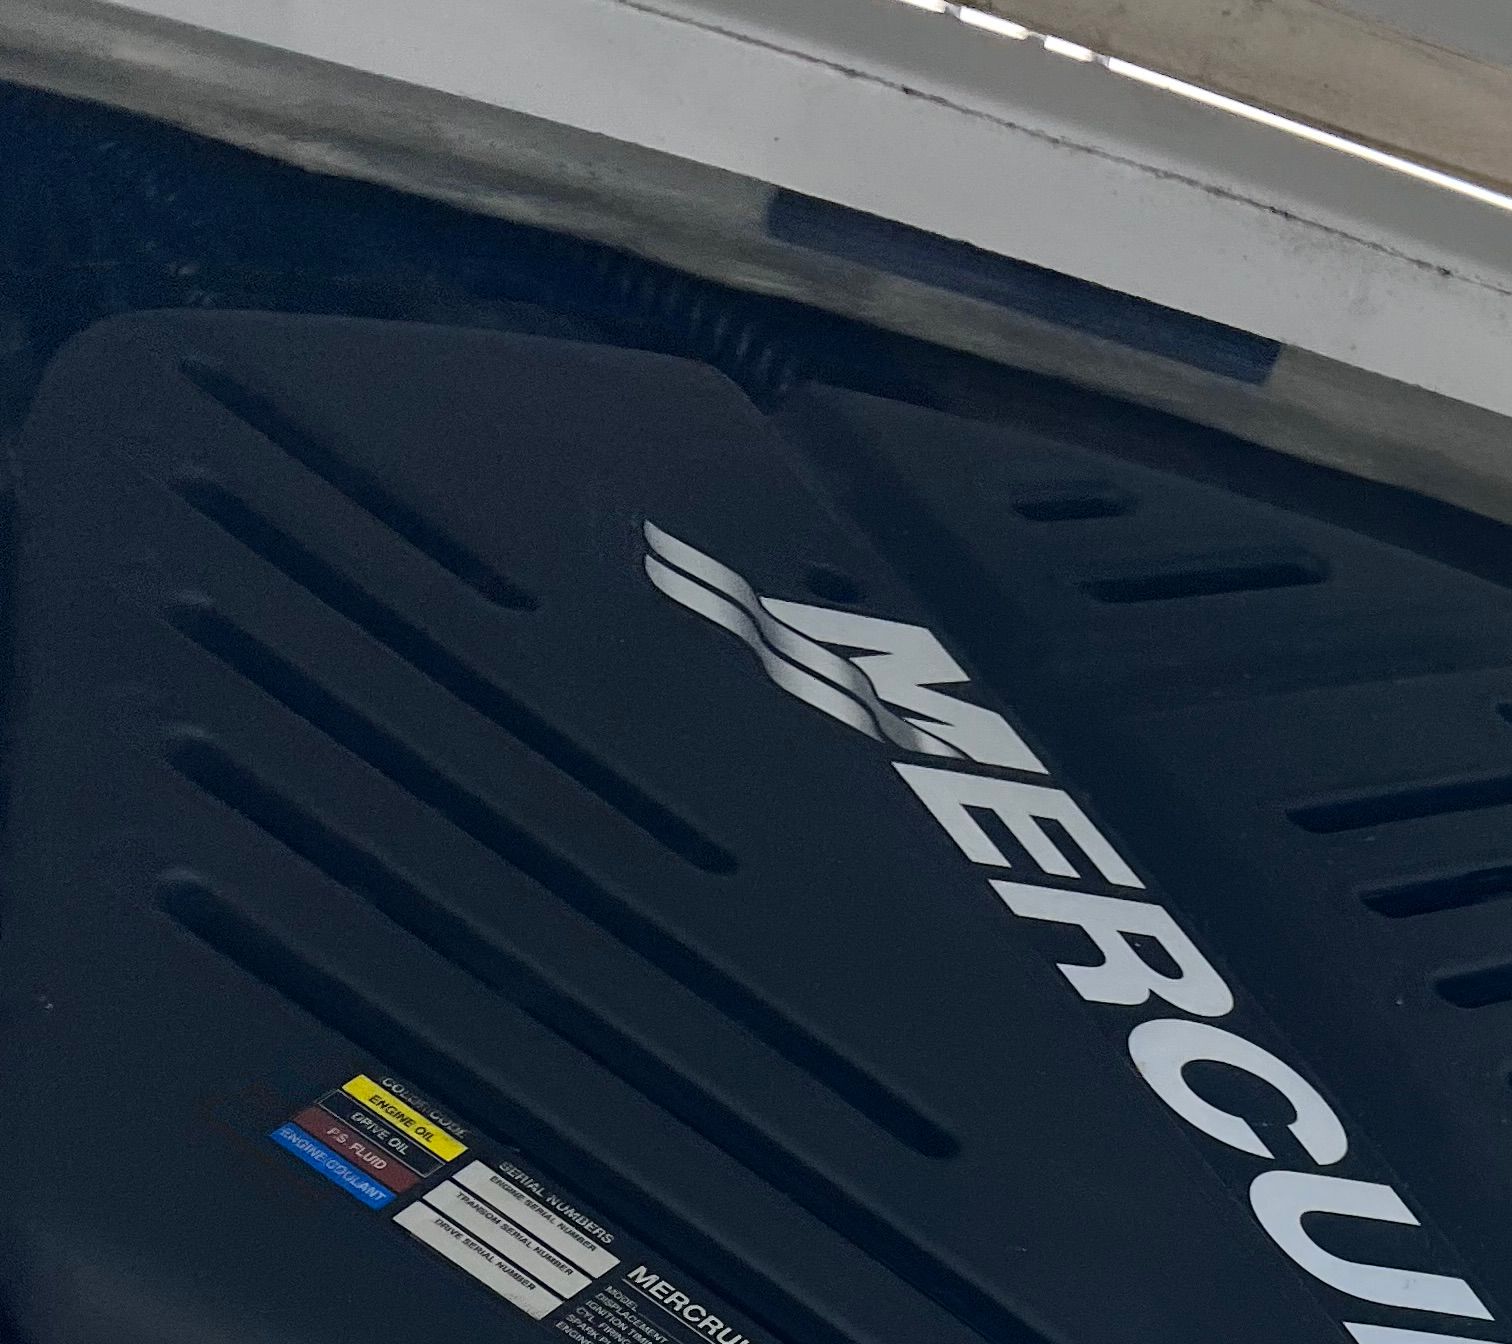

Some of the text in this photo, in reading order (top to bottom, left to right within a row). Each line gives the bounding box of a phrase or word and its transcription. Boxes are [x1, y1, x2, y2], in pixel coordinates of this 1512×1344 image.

[350, 1111, 408, 1156] DRIVE OIL
[368, 1094, 433, 1143] ENGINE OIL
[349, 1141, 387, 1169] FLUID
[566, 1314, 598, 1340] SPARK
[585, 1300, 629, 1333] IGNITION
[595, 1293, 669, 1344] DISPLACEMENT
